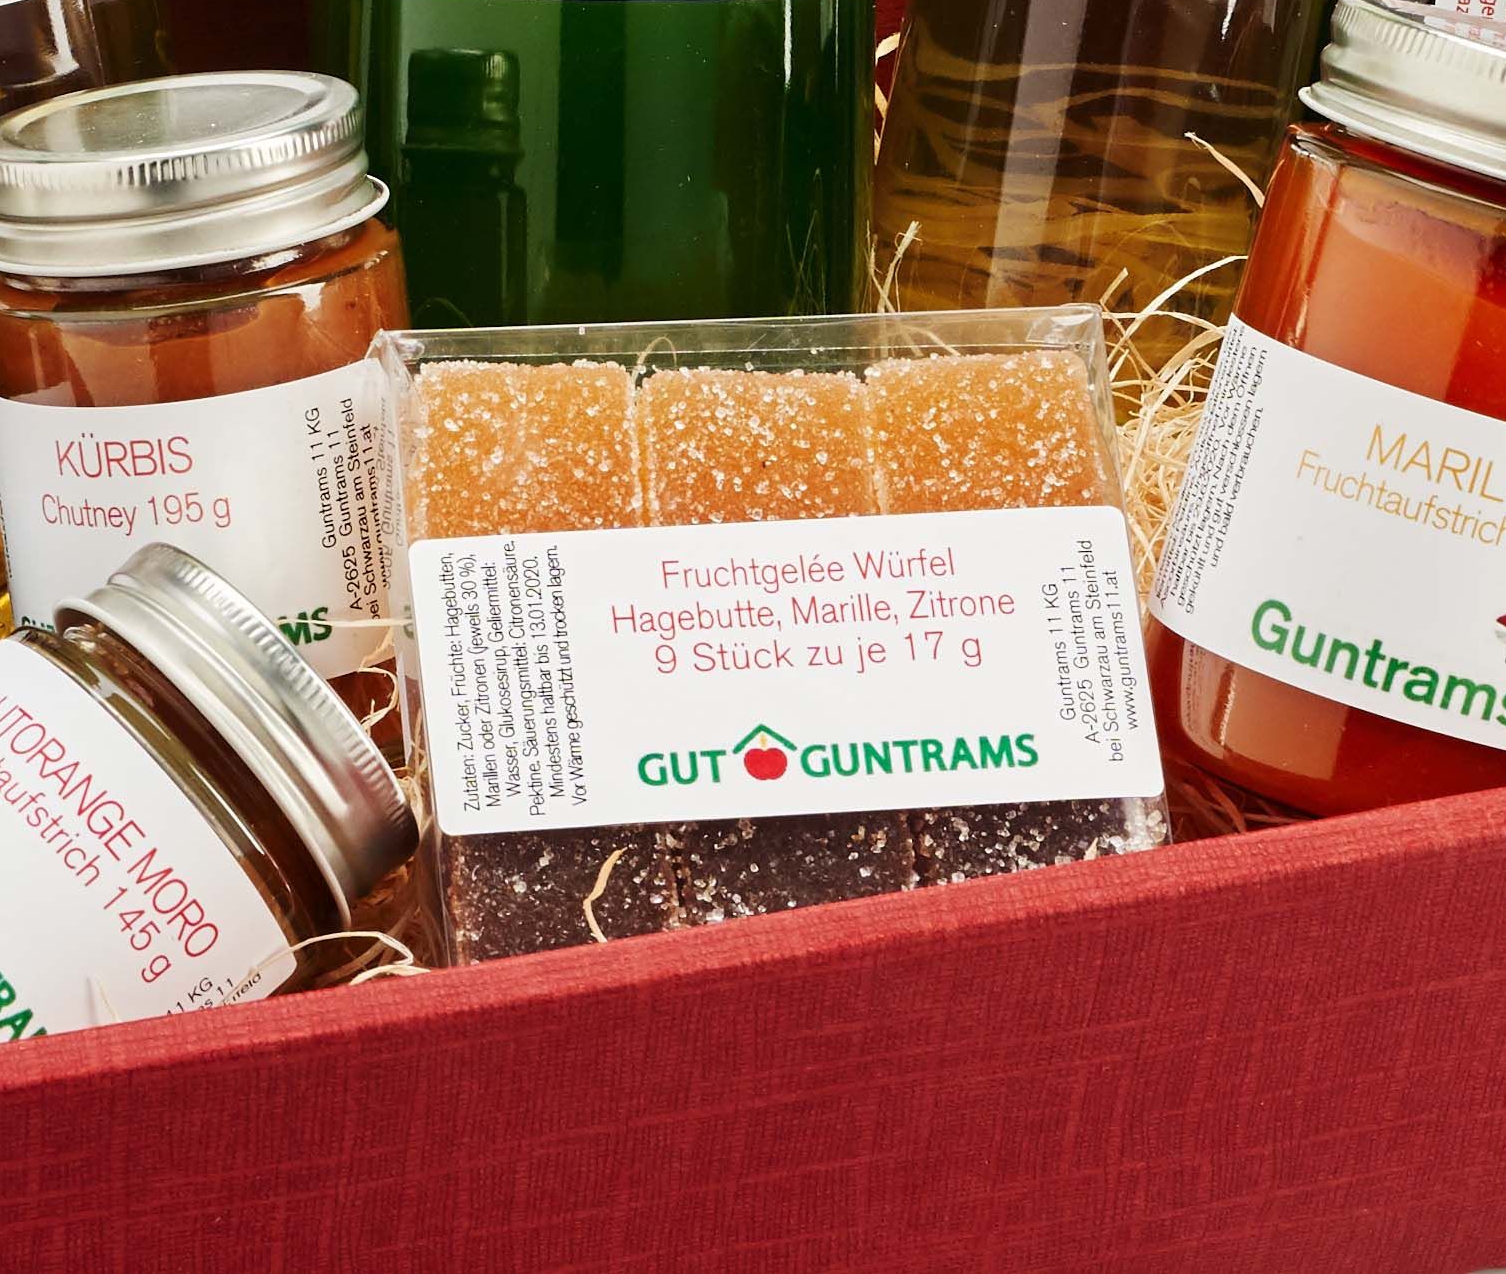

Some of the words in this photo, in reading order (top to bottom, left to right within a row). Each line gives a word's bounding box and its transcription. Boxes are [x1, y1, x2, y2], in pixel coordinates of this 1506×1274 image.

[304, 406, 321, 435] KG
[340, 397, 361, 472] Steinfeld
[56, 432, 193, 479] KÜRBIS
[41, 492, 139, 537] Chutney
[147, 492, 205, 525] 195
[212, 497, 232, 529] g
[316, 466, 337, 548] Guntrams
[333, 454, 353, 537] Guntrams
[352, 474, 365, 501] am
[341, 544, 363, 610] A-2625
[356, 504, 377, 596] Schwarzau
[661, 554, 844, 594] Fruchtgelée
[853, 547, 955, 581] Würfel
[1060, 566, 1077, 582] 11
[1076, 539, 1101, 609] Steinfeld
[438, 551, 463, 636] Hagebutten,
[459, 579, 478, 599] 30
[480, 561, 504, 642] Geliermittel:
[502, 539, 526, 639] Citronensäure.
[521, 555, 546, 638] 13.01.2020.
[612, 599, 782, 640] Hagebutte,
[791, 593, 899, 626] Marille,
[906, 590, 1015, 619] Zitrone
[1041, 582, 1060, 608] KG
[461, 602, 489, 654] (jeweils
[654, 644, 677, 674] 9
[694, 639, 794, 673] Stück
[808, 645, 843, 667] zu
[856, 637, 887, 673] je
[905, 630, 943, 661] 17
[961, 635, 982, 666] g
[1046, 616, 1063, 633] 11
[1067, 589, 1090, 669] Guntrams
[1091, 615, 1106, 639] am
[447, 639, 467, 696] Früchte:
[534, 643, 550, 664] bis
[1054, 640, 1077, 720] Guntrams
[473, 657, 491, 714] Zitronen
[486, 644, 516, 738] Glukosesirup,
[509, 641, 539, 757] Säuerungsmittel:
[536, 667, 555, 714] haltbar
[1076, 678, 1101, 743] A-2625
[1096, 644, 1119, 731] Schwarzau
[454, 698, 474, 750] Zucker,
[477, 718, 495, 749] oder
[1106, 737, 1124, 761] bei
[461, 753, 481, 811] Zutaten:
[504, 740, 522, 797] Wasser,
[544, 716, 565, 797] Mindestens
[637, 749, 727, 786] GUT
[800, 733, 1039, 778] GUNTRAMS
[127, 848, 219, 959] MORO
[101, 886, 161, 951] 145
[141, 955, 173, 985] g
[188, 977, 214, 1004] KG
